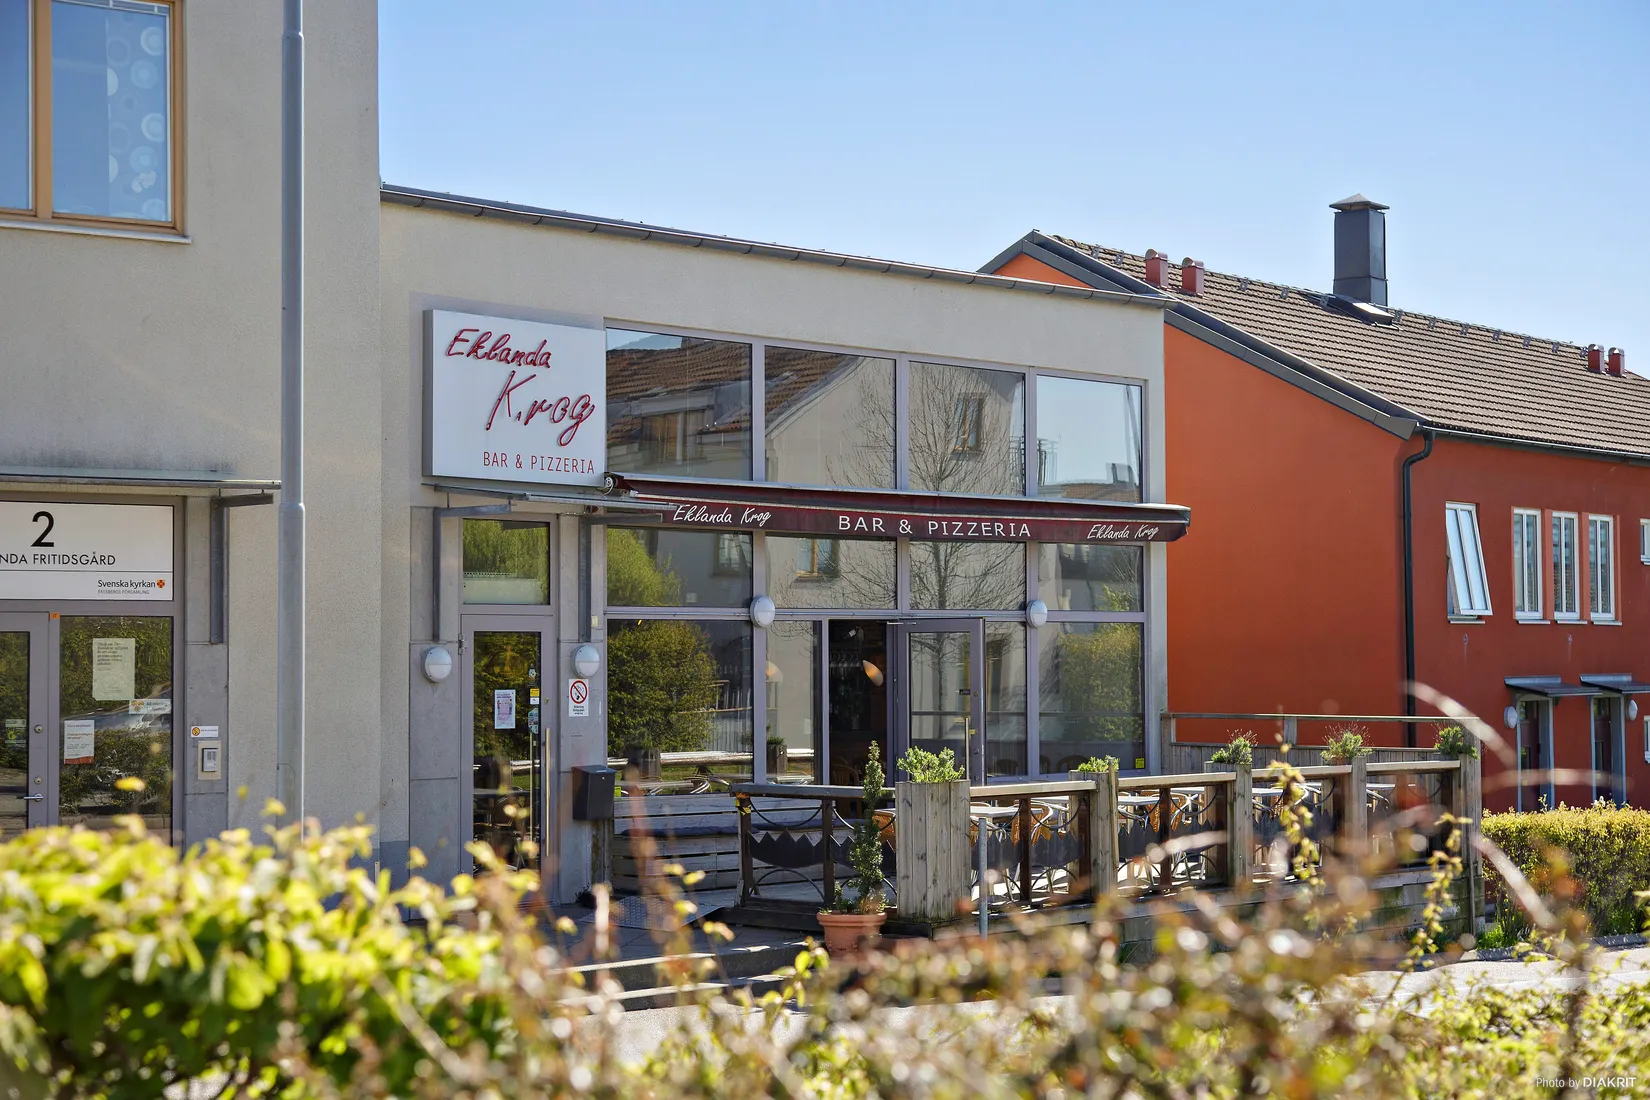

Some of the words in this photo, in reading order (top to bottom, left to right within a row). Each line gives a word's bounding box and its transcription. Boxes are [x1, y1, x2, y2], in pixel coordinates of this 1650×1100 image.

[446, 328, 552, 368] Eklanda
[486, 370, 595, 447] Krog
[483, 451, 508, 468] BAR
[515, 453, 523, 469] &
[531, 455, 595, 475] PIZZERIA
[673, 504, 732, 524] Eklanda
[740, 507, 772, 527] Krog
[838, 515, 886, 533] BAR
[899, 519, 913, 535] &
[928, 521, 1031, 537] PIZZERIA
[30, 510, 55, 548] 2
[1087, 524, 1130, 540] Eklanda
[1134, 524, 1160, 540] Krog
[0, 553, 28, 565] NDA
[33, 551, 116, 566] FRITIDSGÅRD
[97, 579, 129, 588] Svenska
[130, 579, 156, 590] kyrkan
